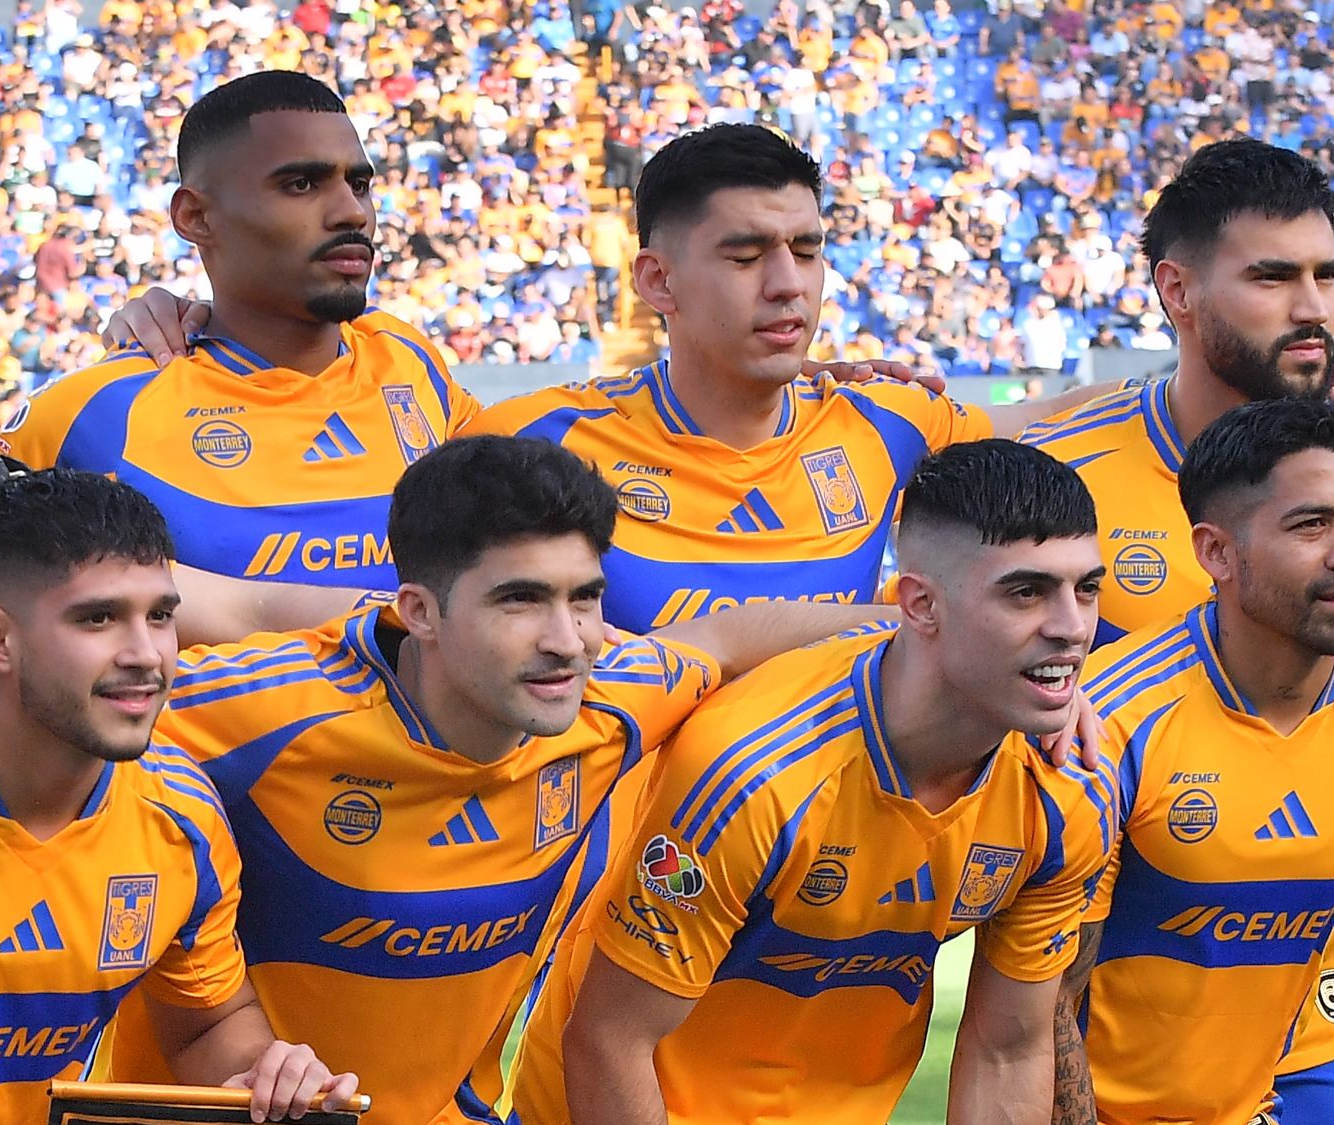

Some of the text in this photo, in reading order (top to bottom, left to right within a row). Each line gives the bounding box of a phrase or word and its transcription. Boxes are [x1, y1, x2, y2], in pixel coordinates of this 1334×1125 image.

[200, 405, 246, 416] CEMEX
[194, 436, 249, 452] MONTERREY
[809, 454, 847, 471] TIGRES
[627, 465, 672, 477] CEMEX
[833, 513, 859, 526] UANL
[1124, 530, 1168, 540] CEMEX
[301, 534, 395, 571] CEM
[1115, 562, 1165, 578] MONTERREY
[346, 774, 396, 790] CEMEX
[1183, 773, 1220, 784] CEMEX
[325, 806, 379, 827] MONTERREY
[1170, 809, 1217, 824] MONTERREY
[544, 823, 564, 840] UANL
[974, 849, 1017, 867] TIGRES
[112, 882, 153, 897] TIGRES
[803, 875, 847, 891] ONTERREY
[956, 905, 982, 916] UANL
[605, 901, 694, 965] CHIREY
[109, 951, 135, 962] UANL
[815, 954, 933, 986] CEME
